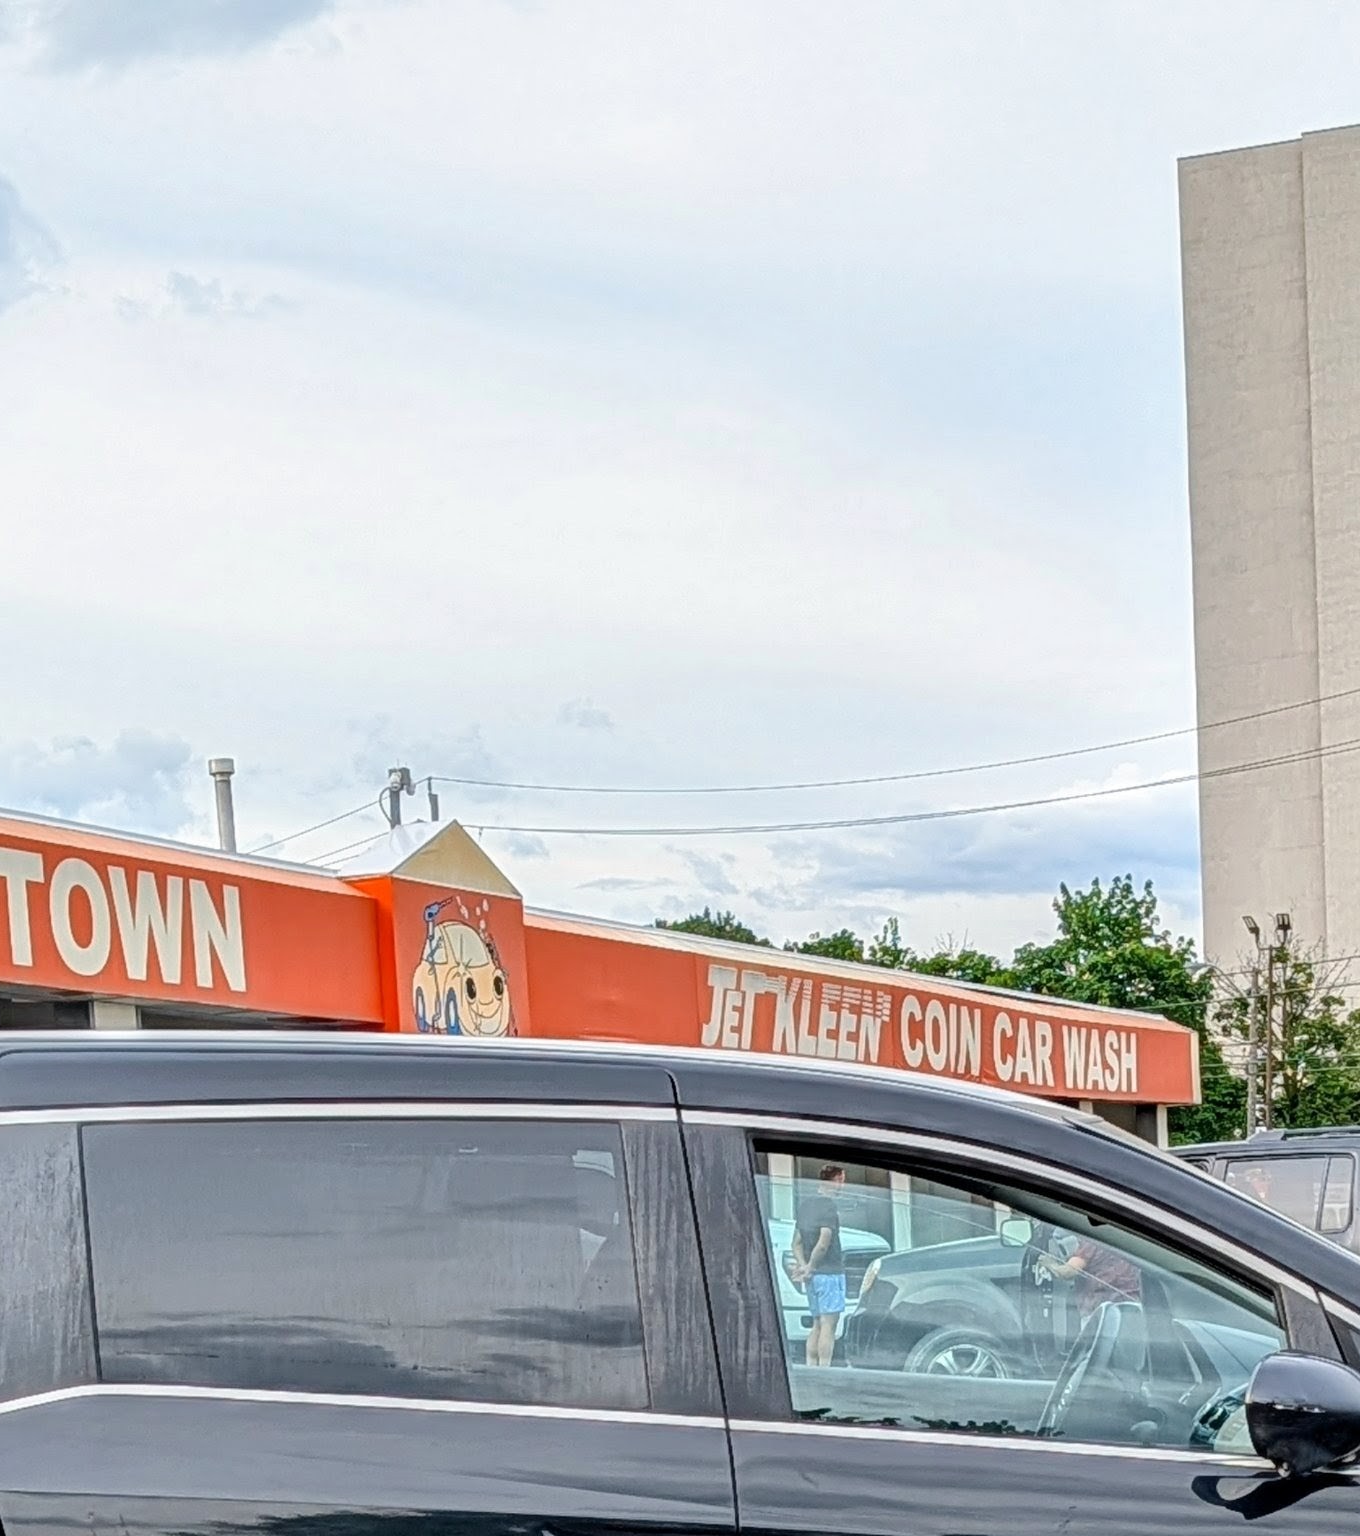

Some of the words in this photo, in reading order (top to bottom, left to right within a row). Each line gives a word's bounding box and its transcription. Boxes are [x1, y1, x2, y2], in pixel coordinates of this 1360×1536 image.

[770, 975, 892, 1064] KLEEN
[900, 994, 982, 1076] COIN
[993, 1011, 1055, 1087] CAR
[1061, 1024, 1139, 1094] WASH
